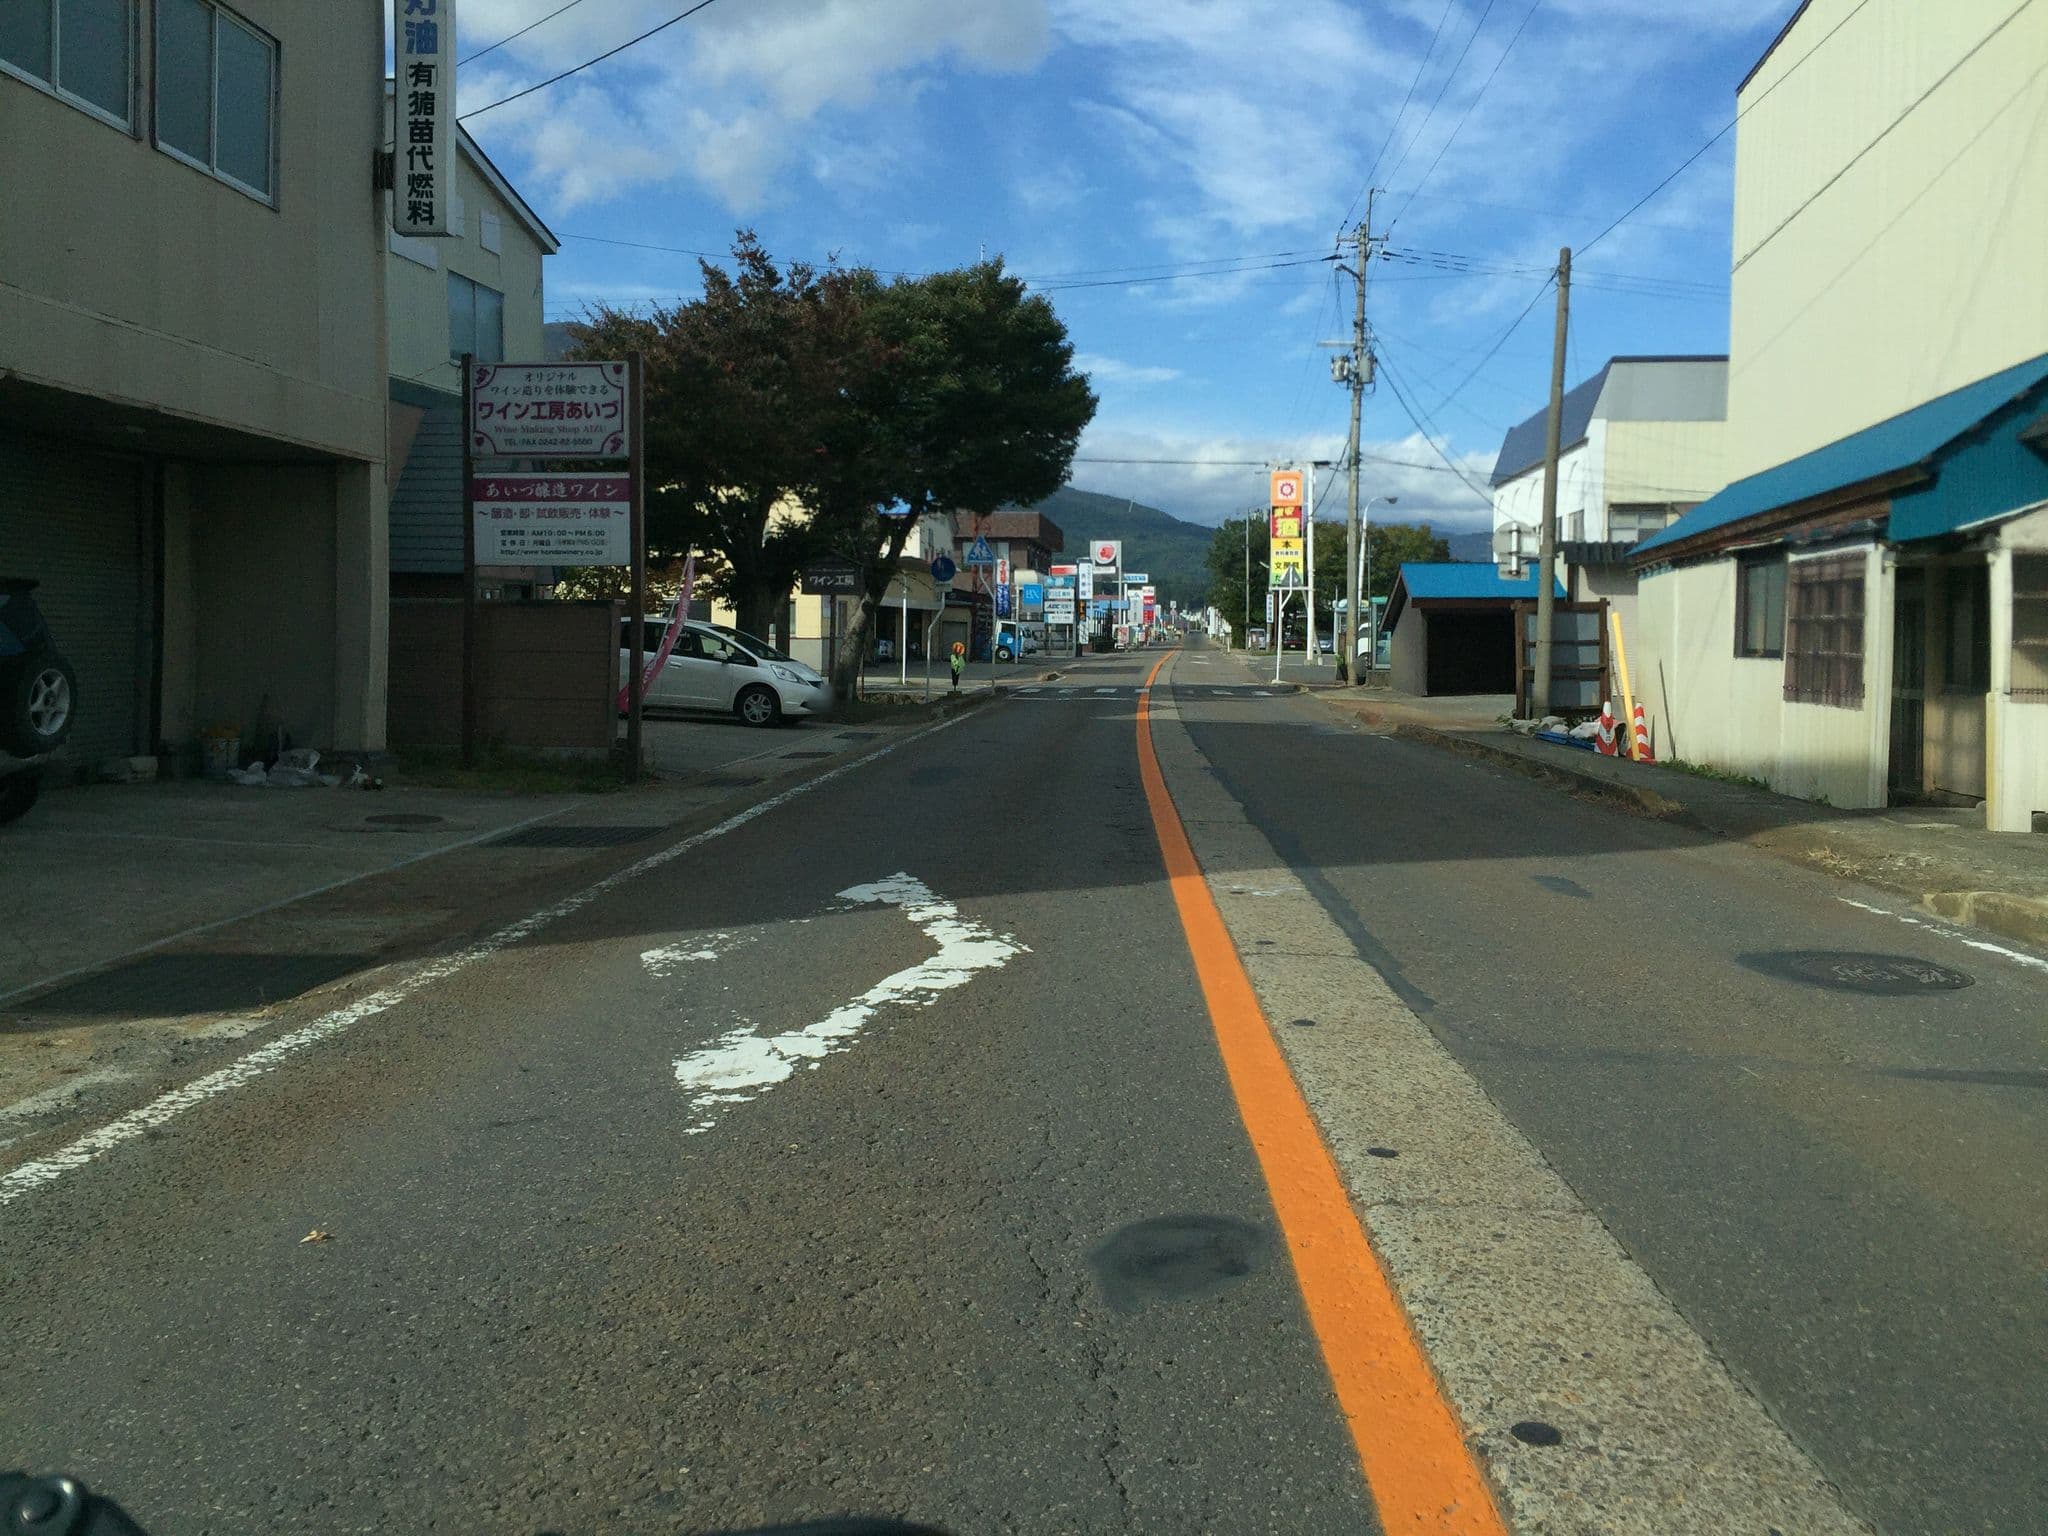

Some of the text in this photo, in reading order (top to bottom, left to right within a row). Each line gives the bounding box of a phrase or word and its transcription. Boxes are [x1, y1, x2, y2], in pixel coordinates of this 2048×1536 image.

[524, 372, 577, 382] オリジナル
[478, 400, 619, 421] ワイン工房あいづ
